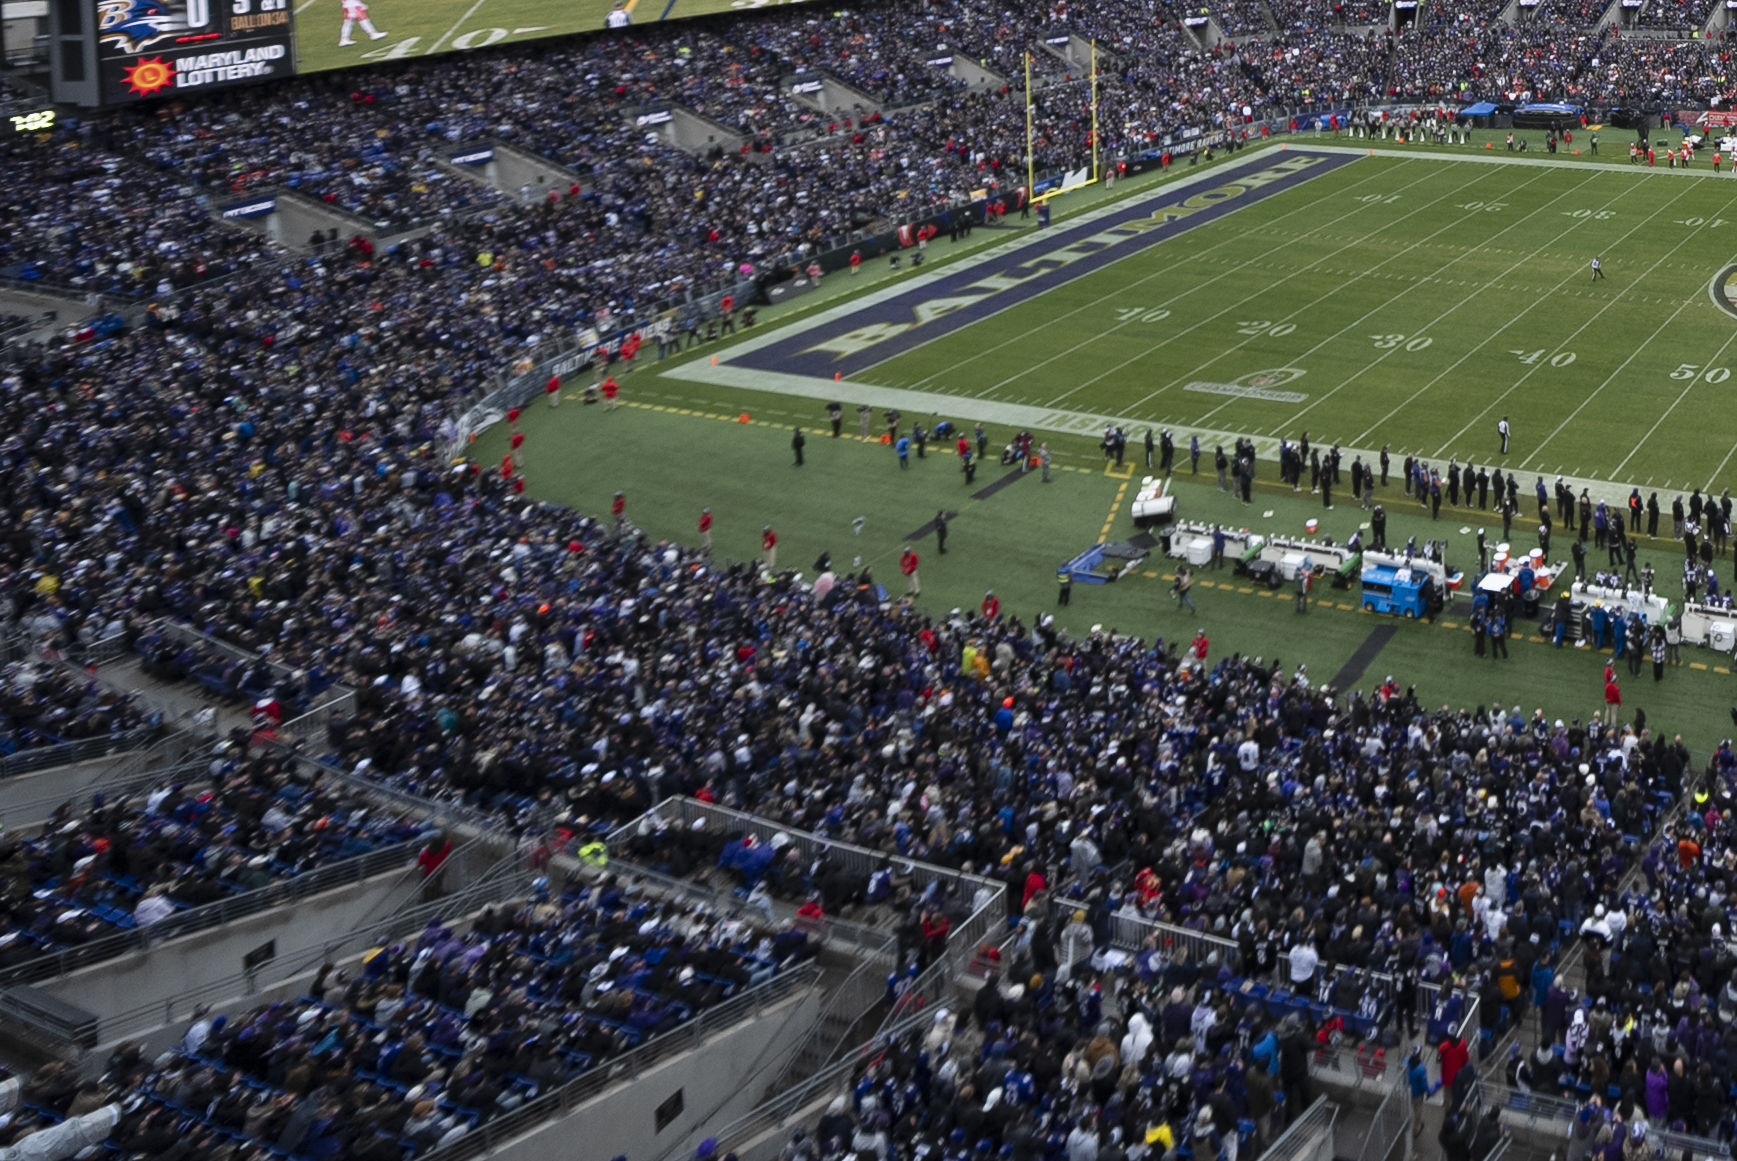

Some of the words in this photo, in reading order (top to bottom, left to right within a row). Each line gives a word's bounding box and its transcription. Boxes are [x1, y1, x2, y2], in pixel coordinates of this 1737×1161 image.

[176, 44, 286, 72] MARYLAND
[177, 60, 267, 88] LOTTERY
[794, 154, 1329, 362] BALTIMORE
[1237, 321, 1297, 337] 20
[1373, 334, 1434, 352] 30
[1515, 349, 1578, 368] 40
[1669, 363, 1731, 384] 50
